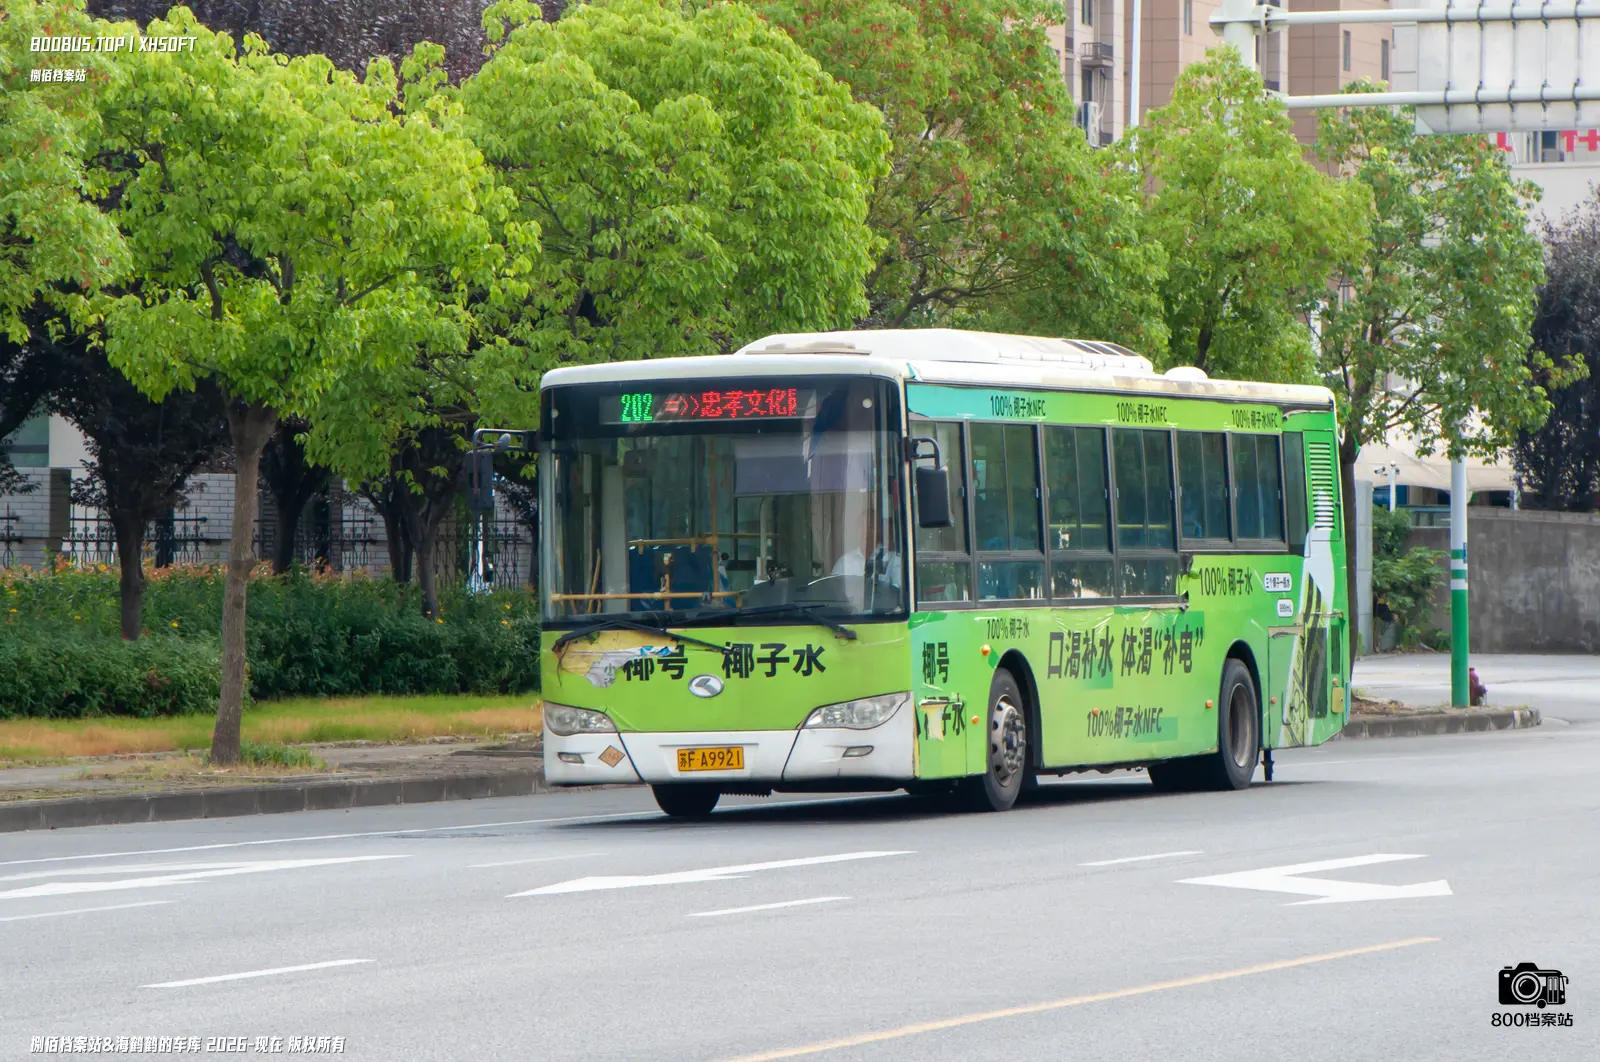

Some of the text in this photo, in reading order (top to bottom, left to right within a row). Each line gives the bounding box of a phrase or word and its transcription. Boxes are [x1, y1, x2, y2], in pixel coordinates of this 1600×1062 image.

[621, 393, 652, 422] 202
[722, 642, 827, 679] 椰子水
[922, 641, 950, 685] 椰号
[1047, 626, 1114, 680] 口渴补水
